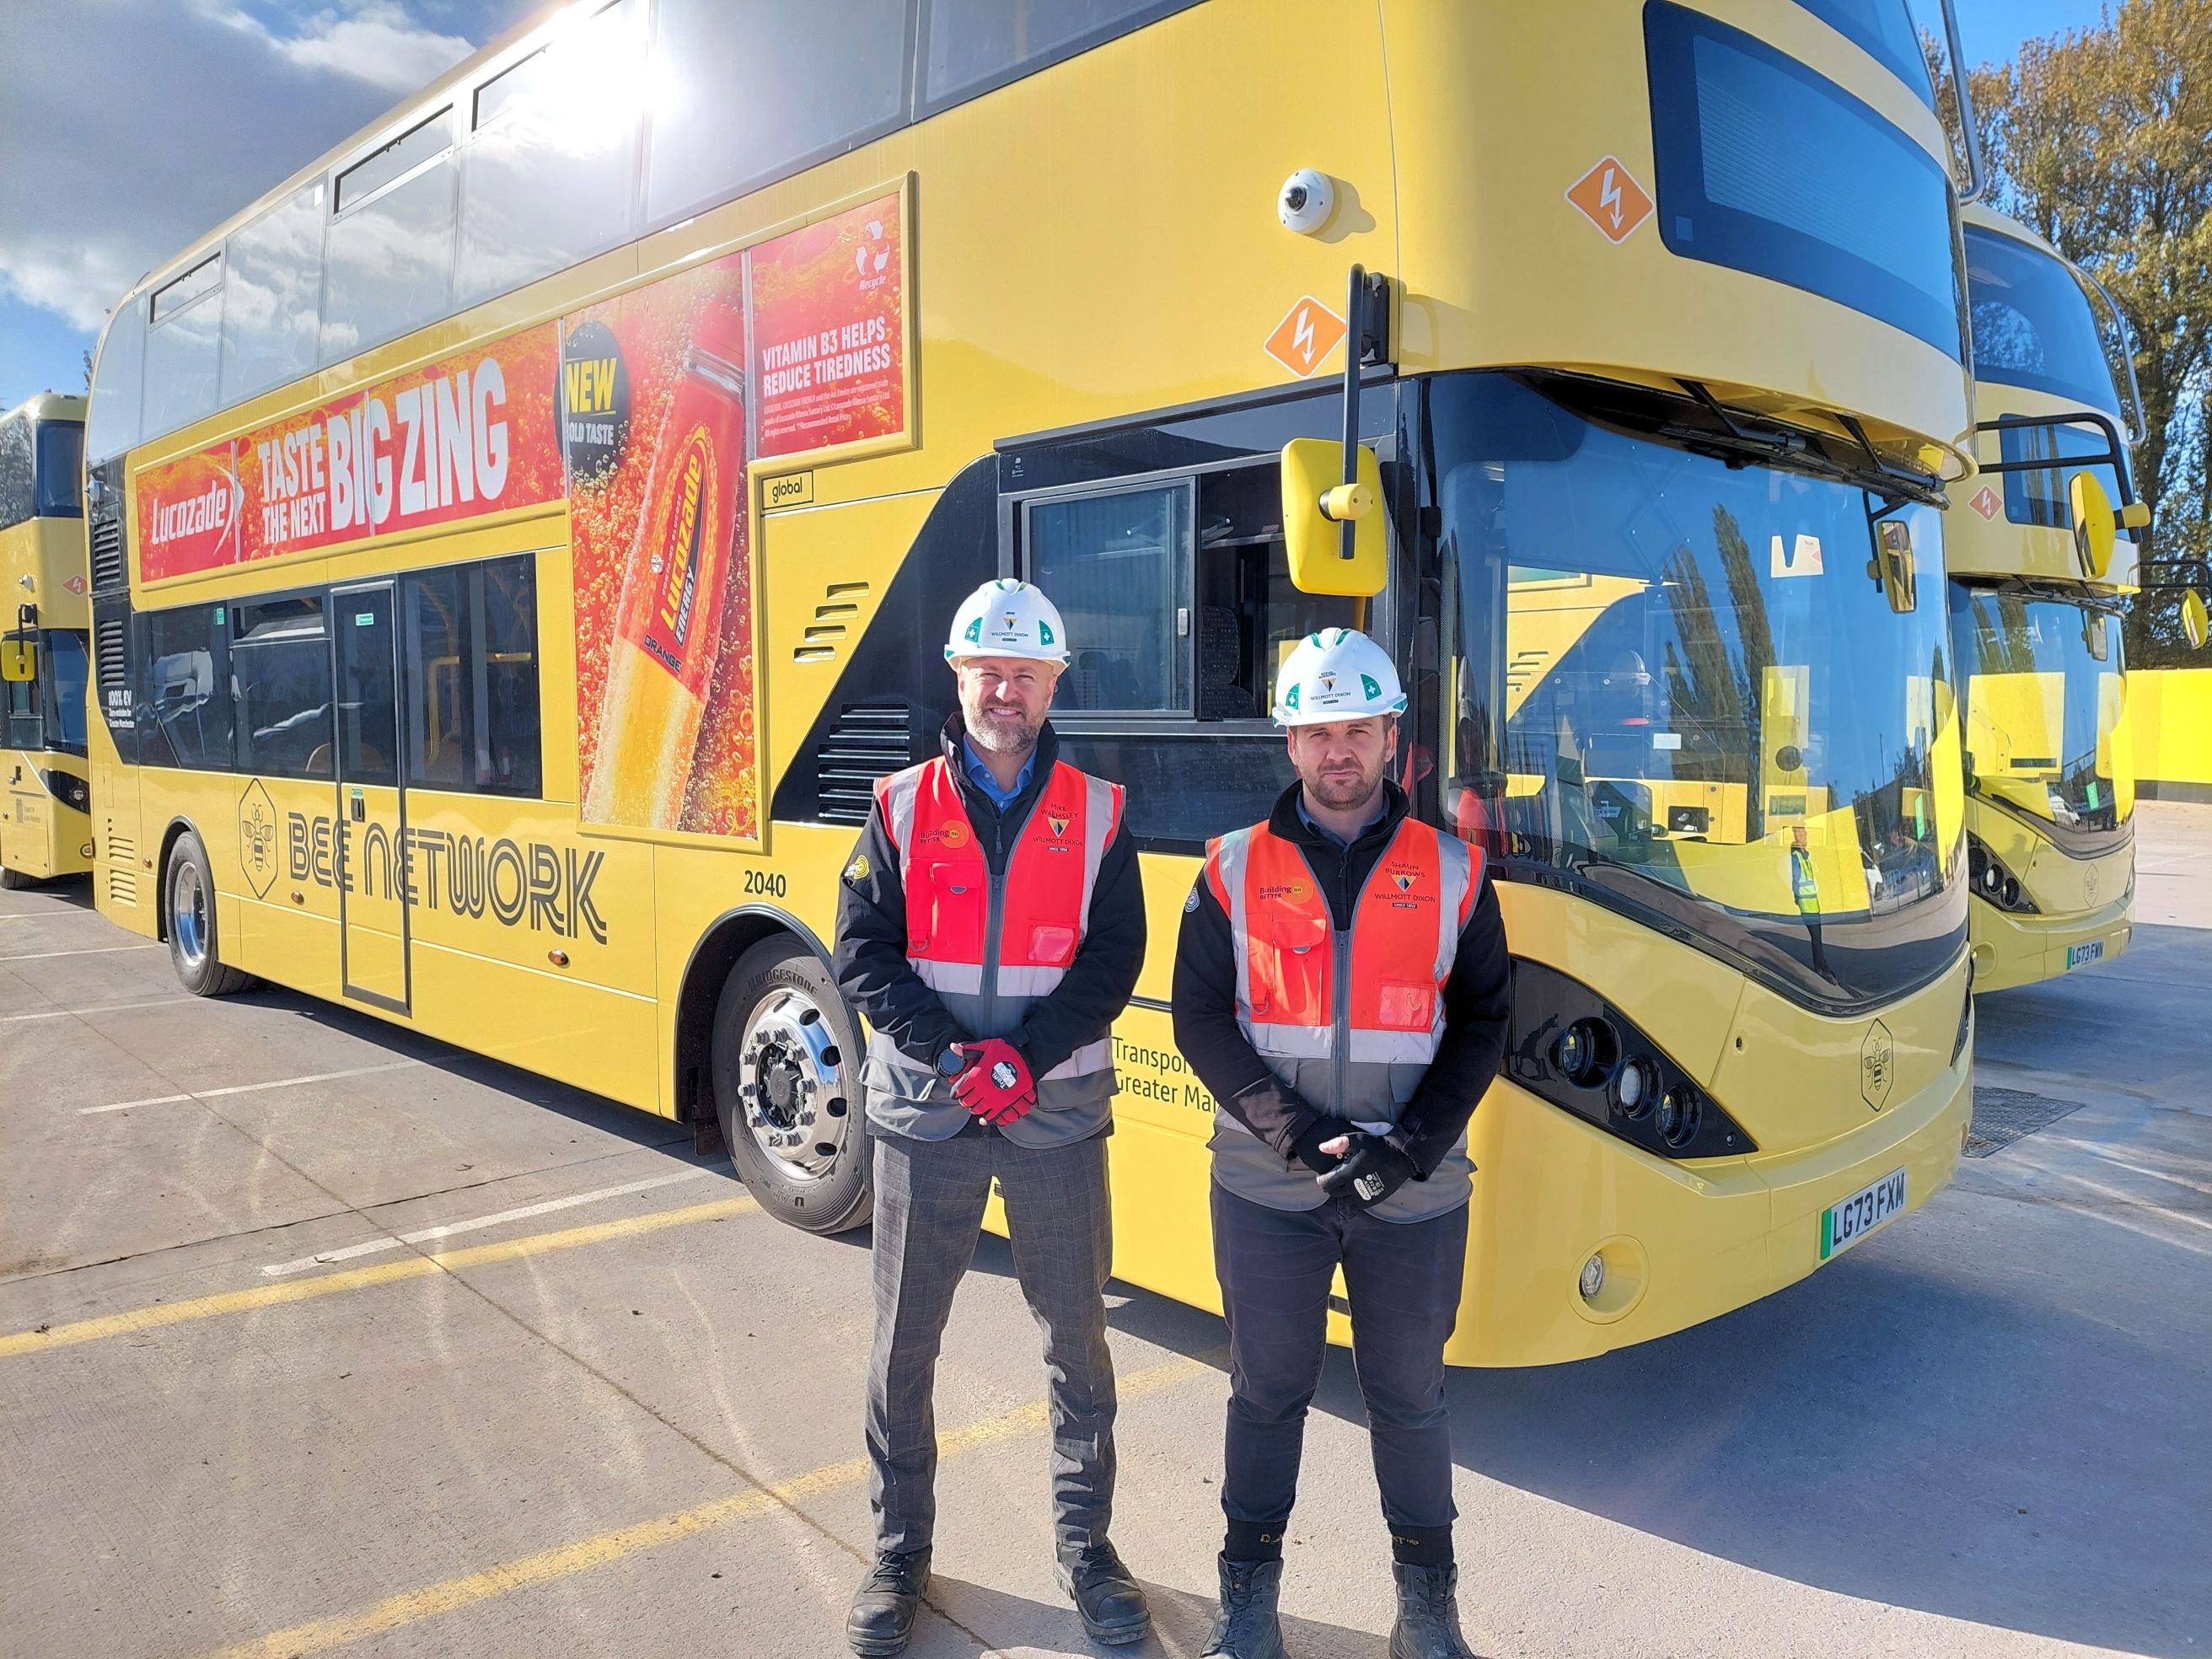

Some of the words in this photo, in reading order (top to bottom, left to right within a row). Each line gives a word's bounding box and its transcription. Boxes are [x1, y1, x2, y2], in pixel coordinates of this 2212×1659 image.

[859, 275, 887, 291] Recycle
[763, 335, 817, 371] VITAMIN
[820, 329, 839, 356] B3
[841, 315, 885, 350] HELPS
[566, 357, 617, 414] NEW
[763, 363, 812, 398] REDUCE
[813, 343, 891, 384] TIREDNESS
[327, 397, 393, 531] BIG
[395, 357, 509, 516] ZING
[567, 421, 585, 443] OLD
[585, 423, 615, 445] TASTE
[257, 423, 325, 502] TASTE
[772, 476, 803, 503] global
[151, 479, 227, 545] Lucozade
[262, 502, 287, 545] THE
[290, 491, 325, 540] NEXT
[660, 454, 702, 631] Lucozade
[675, 565, 695, 645] ENERGY
[644, 634, 682, 673] ORANGE
[123, 690, 132, 706] EV
[1050, 803, 1067, 812] MIKE
[921, 829, 949, 839] Building
[1065, 839, 1083, 847] DIXON
[288, 812, 354, 893] BEE
[363, 822, 608, 945] NETWORK
[1385, 867, 1426, 878] BURROWS
[1390, 861, 1419, 870] SHAUN
[744, 869, 787, 899] 2040
[1259, 885, 1292, 894] Building
[2071, 944, 2090, 965] LG73
[749, 968, 819, 998] BRIDGESTONE
[1833, 1191, 1874, 1247] LG73
[1876, 1172, 1905, 1220] FXM
